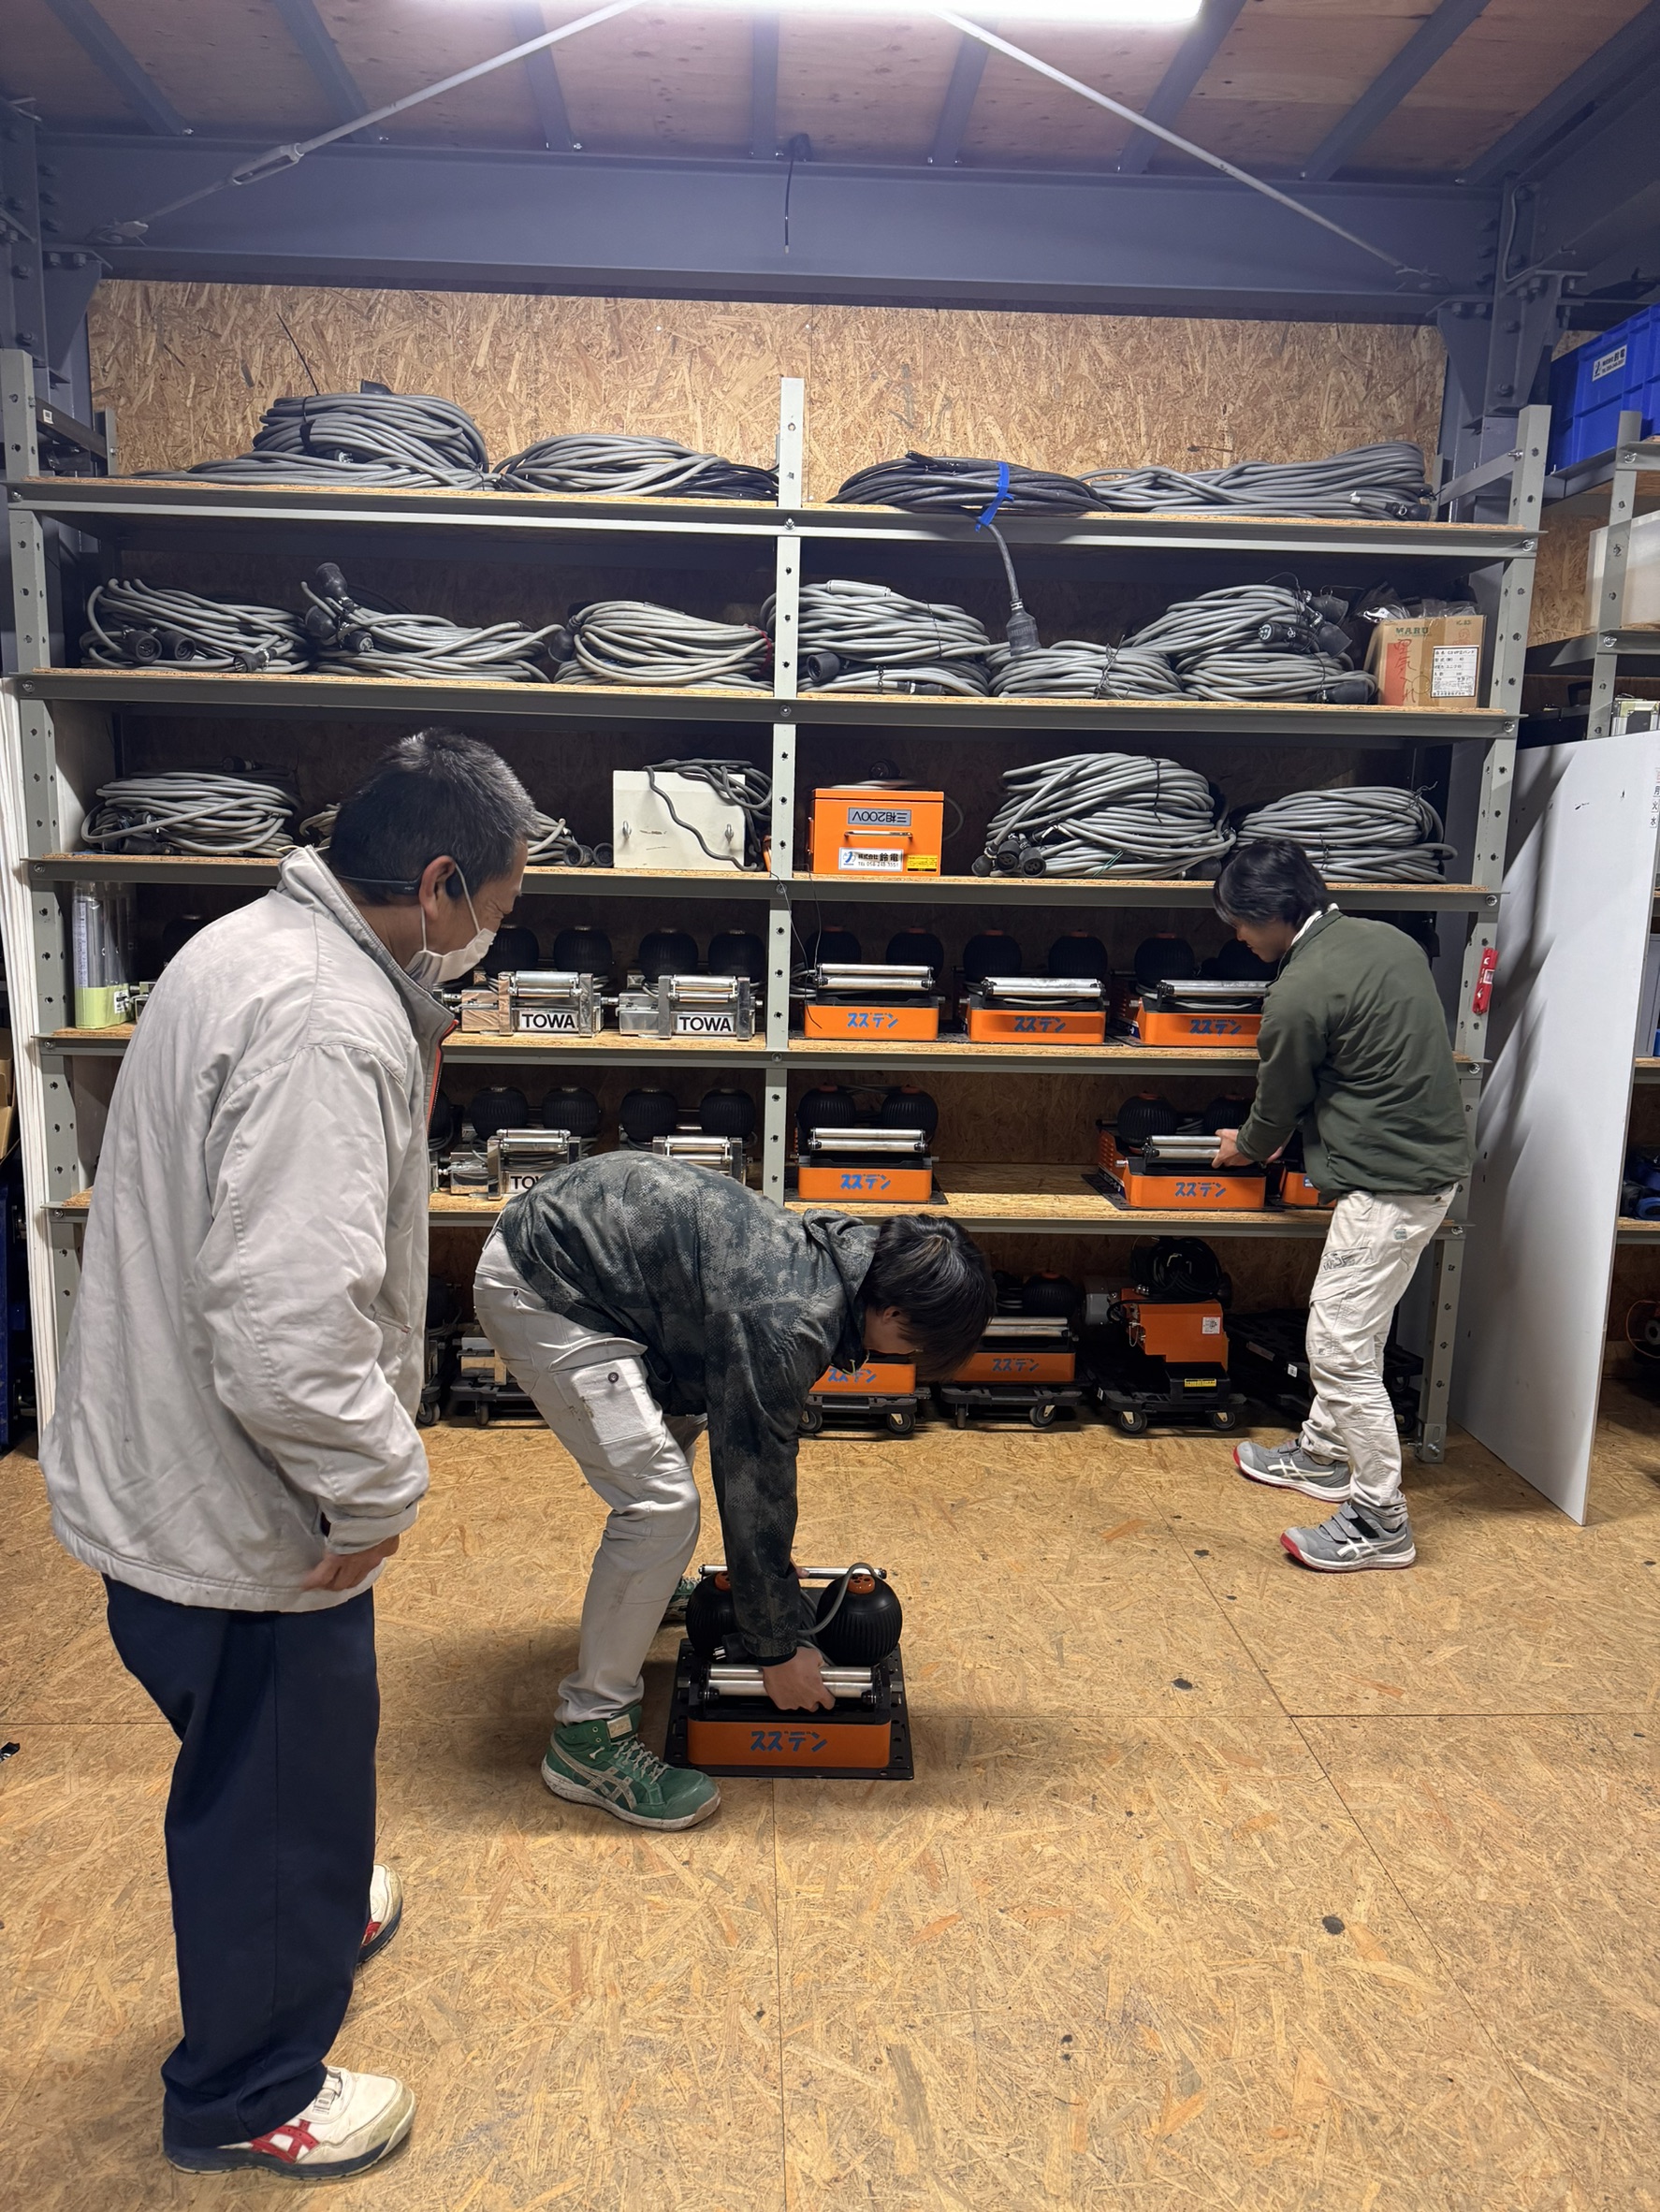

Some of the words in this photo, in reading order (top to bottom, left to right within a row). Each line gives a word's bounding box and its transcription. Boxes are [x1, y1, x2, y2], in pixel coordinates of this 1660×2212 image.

[852, 810, 908, 823] 三相200V
[521, 1013, 575, 1029] TOWA
[678, 1016, 732, 1032] TOWA
[847, 1012, 899, 1028] スズデン
[1013, 1016, 1067, 1033] スズデン
[1188, 1018, 1242, 1036] スズデン
[510, 1175, 539, 1189] TO
[840, 1173, 892, 1190] スズデン
[1174, 1182, 1227, 1198] スズデン
[992, 1358, 1040, 1372] スズデン
[750, 1730, 828, 1753] スズデン
